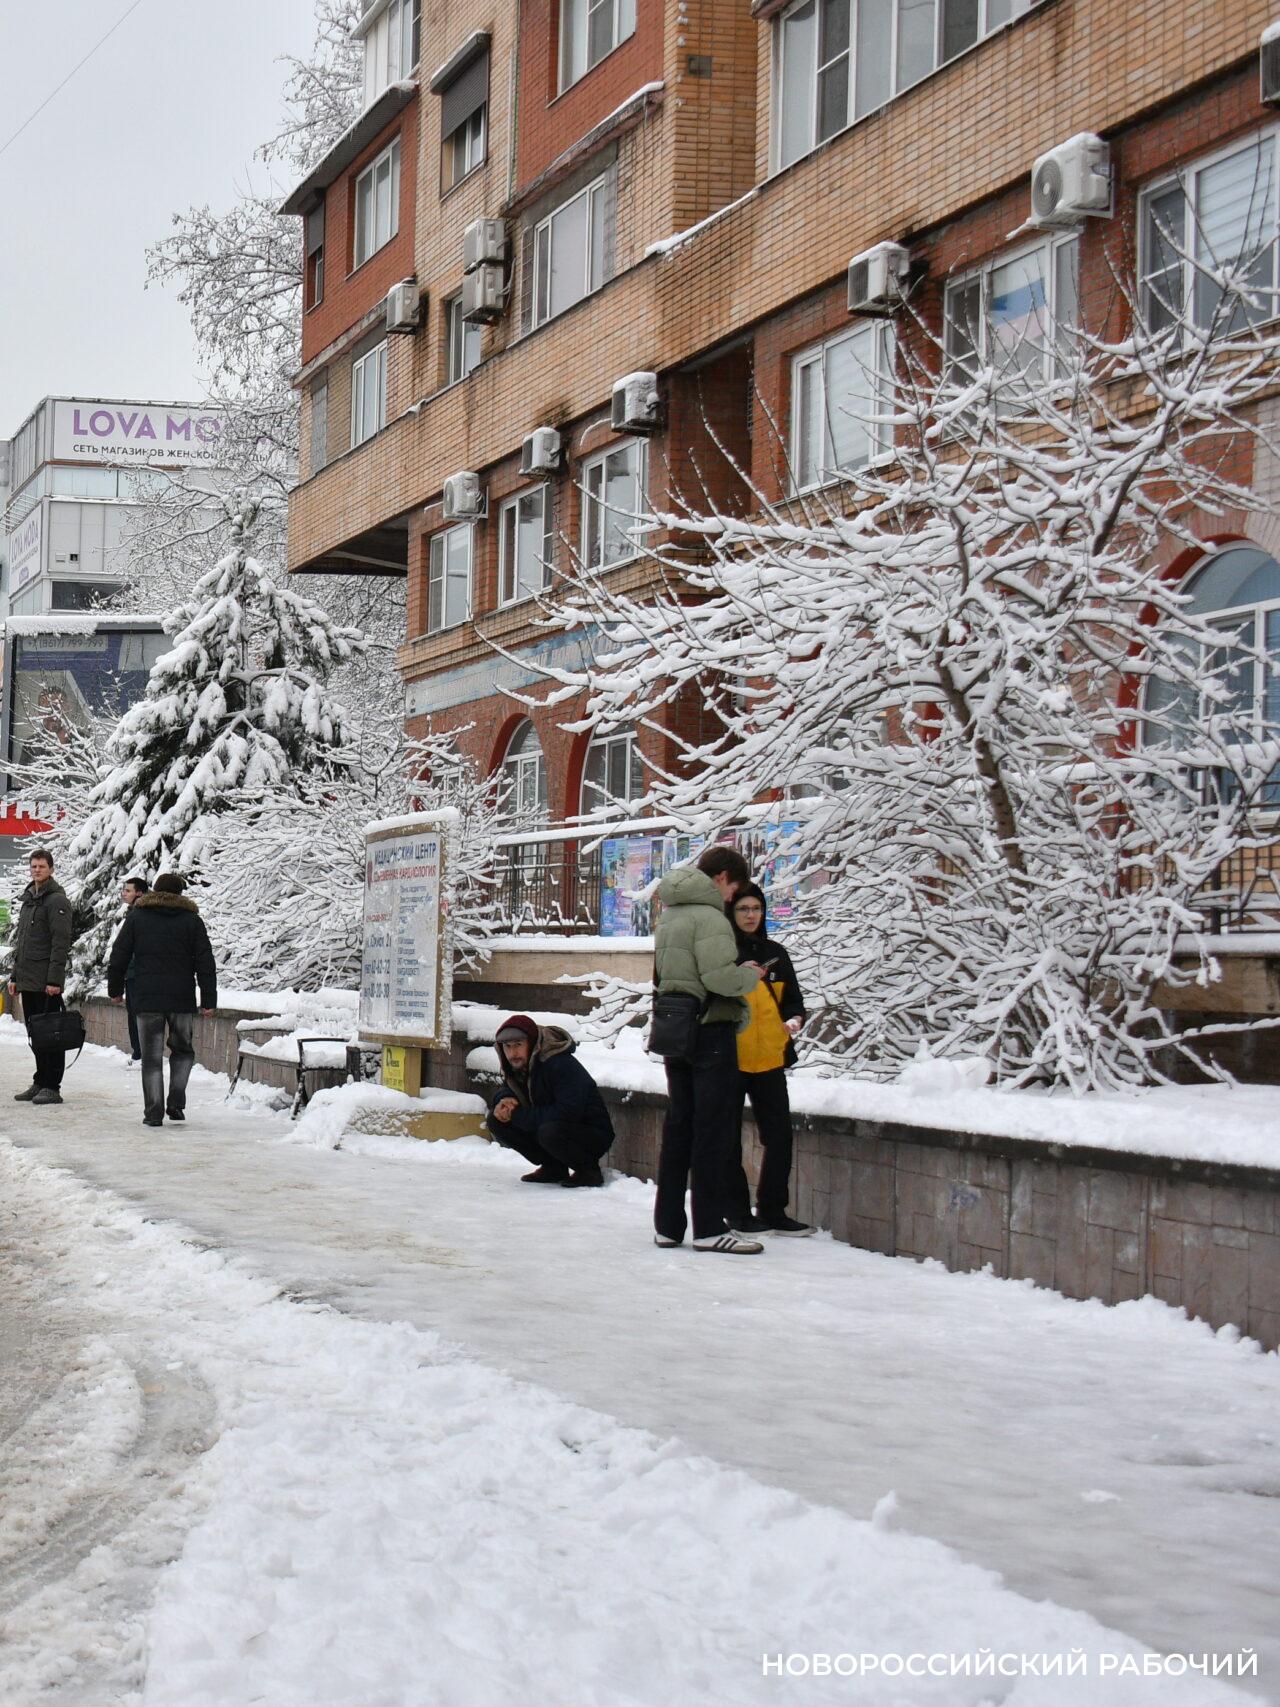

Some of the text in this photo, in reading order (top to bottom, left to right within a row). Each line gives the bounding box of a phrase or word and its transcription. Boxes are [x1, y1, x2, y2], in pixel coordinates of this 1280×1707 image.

[73, 409, 157, 440] LOVA
[73, 444, 98, 454] СЕТЬ
[415, 842, 437, 859] ЦЕНТР
